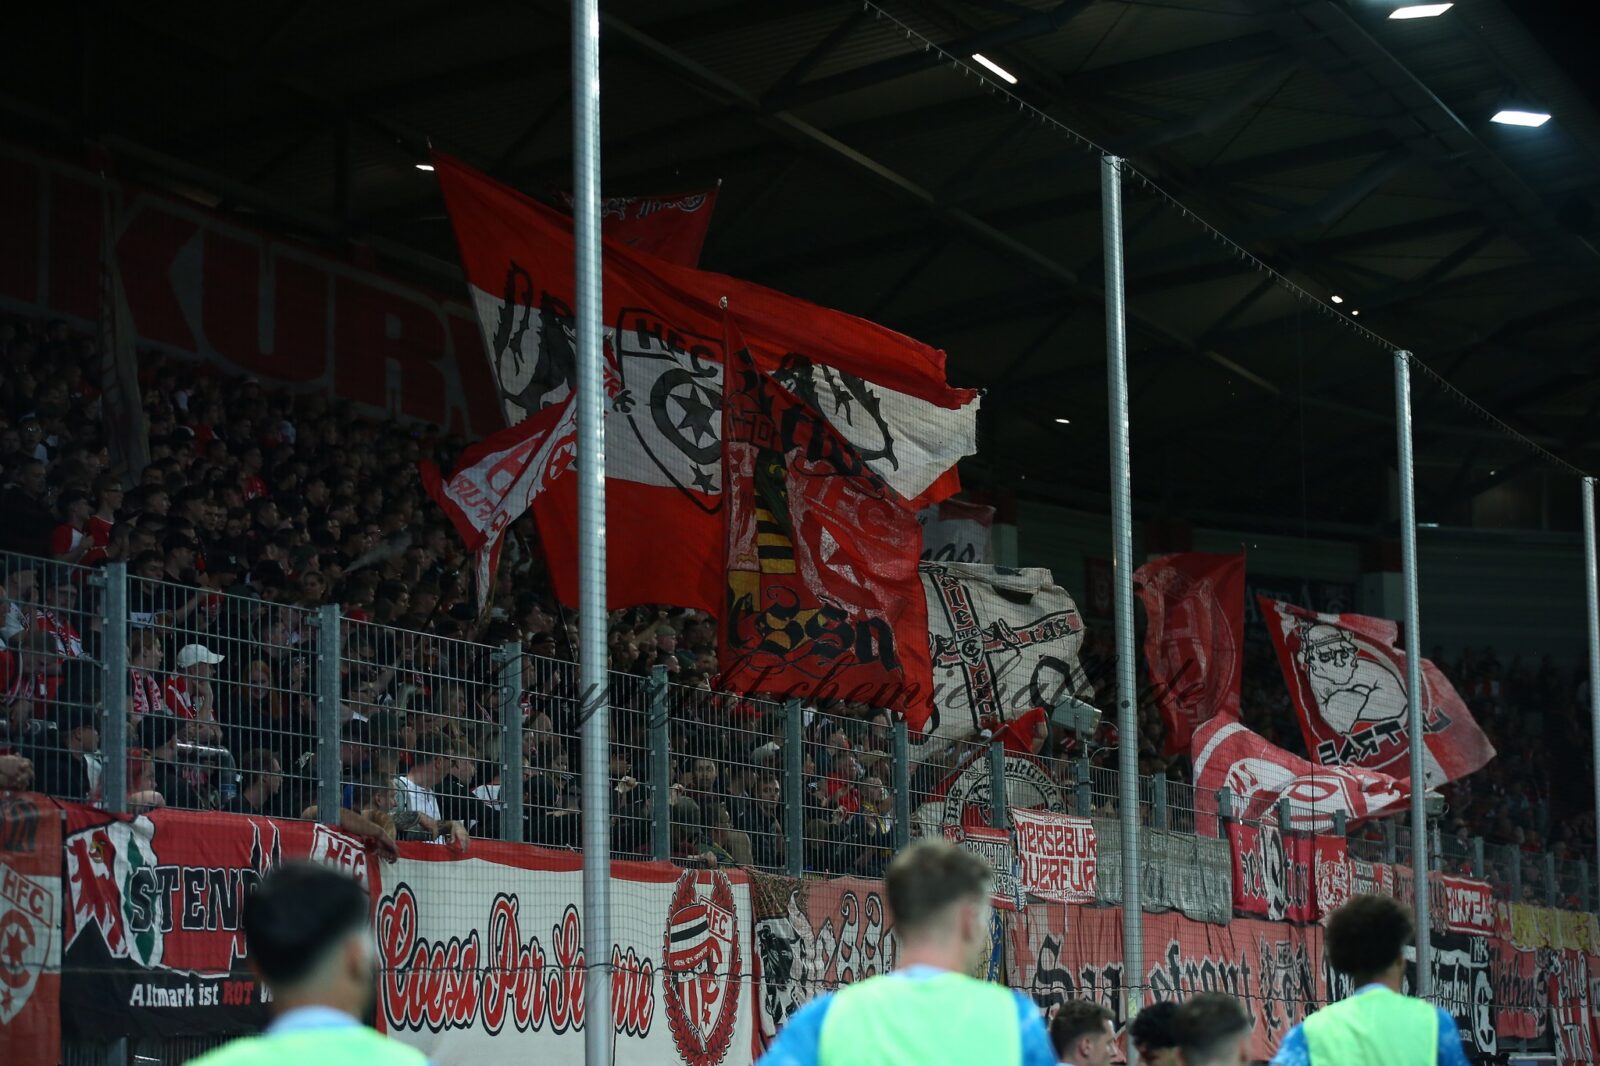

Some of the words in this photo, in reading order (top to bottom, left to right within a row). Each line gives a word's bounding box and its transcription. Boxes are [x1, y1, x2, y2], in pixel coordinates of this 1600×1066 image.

[635, 317, 719, 379] HFC
[957, 628, 980, 642] HFC
[325, 836, 368, 883] HFC
[2, 872, 46, 915] HFC
[481, 892, 547, 1036] Per
[547, 904, 656, 1038] Sepre
[1030, 934, 1257, 1034] Saaefront
[129, 982, 195, 1008] Altmark
[199, 982, 219, 1007] ist
[222, 981, 254, 1007] ROT
